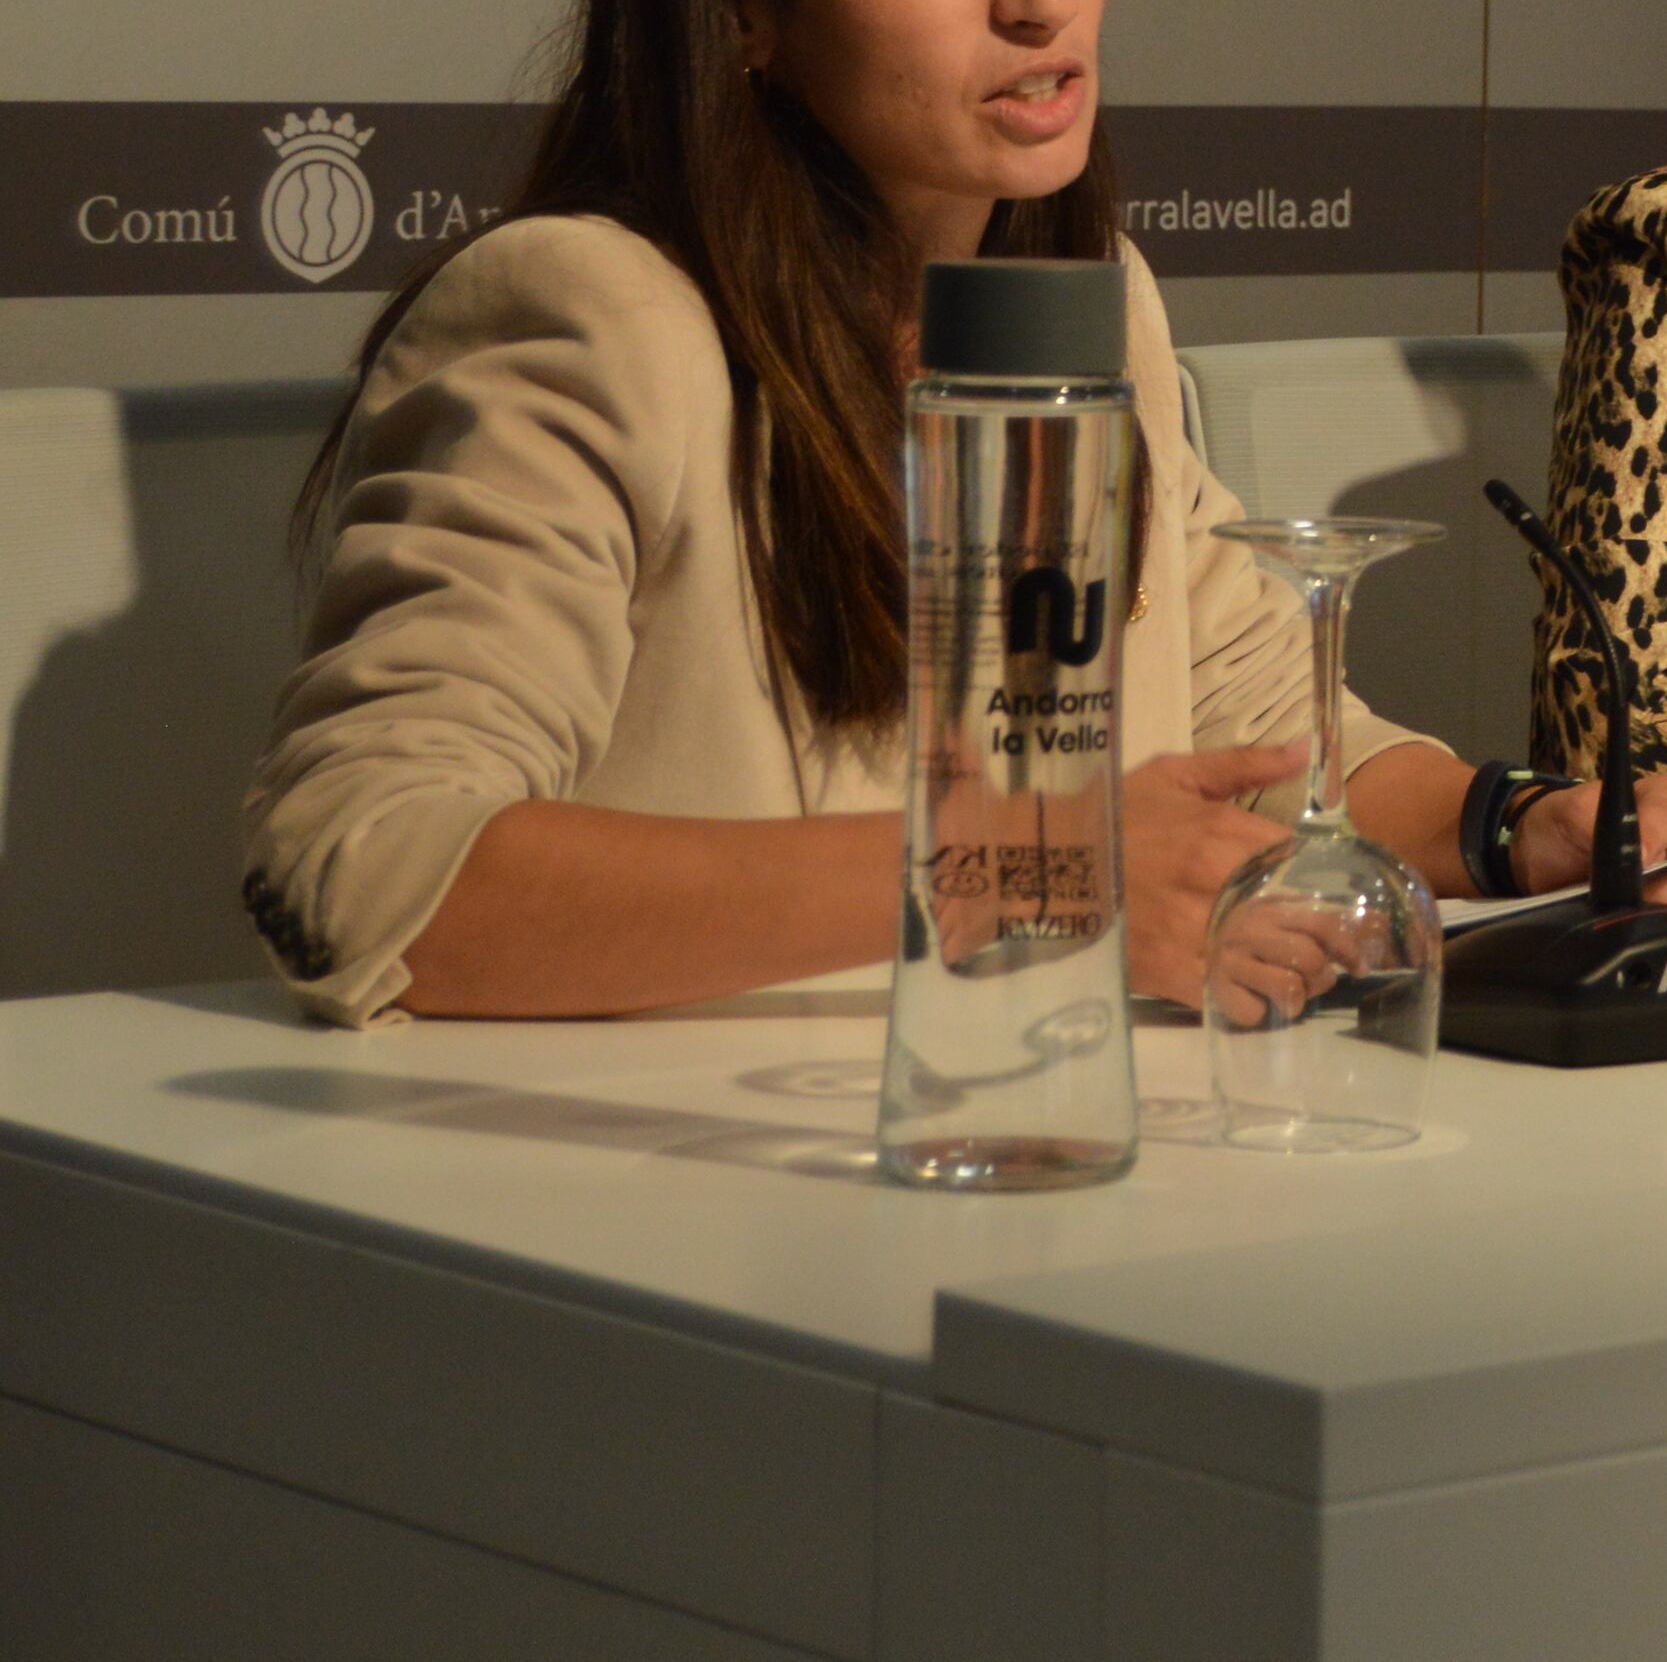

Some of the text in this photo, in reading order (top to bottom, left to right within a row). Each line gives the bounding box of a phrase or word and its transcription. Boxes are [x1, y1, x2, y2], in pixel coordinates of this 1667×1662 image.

[77, 194, 236, 244] Comú
[1113, 188, 1351, 230] rralavella.ad
[992, 724, 1108, 754] la Vella
